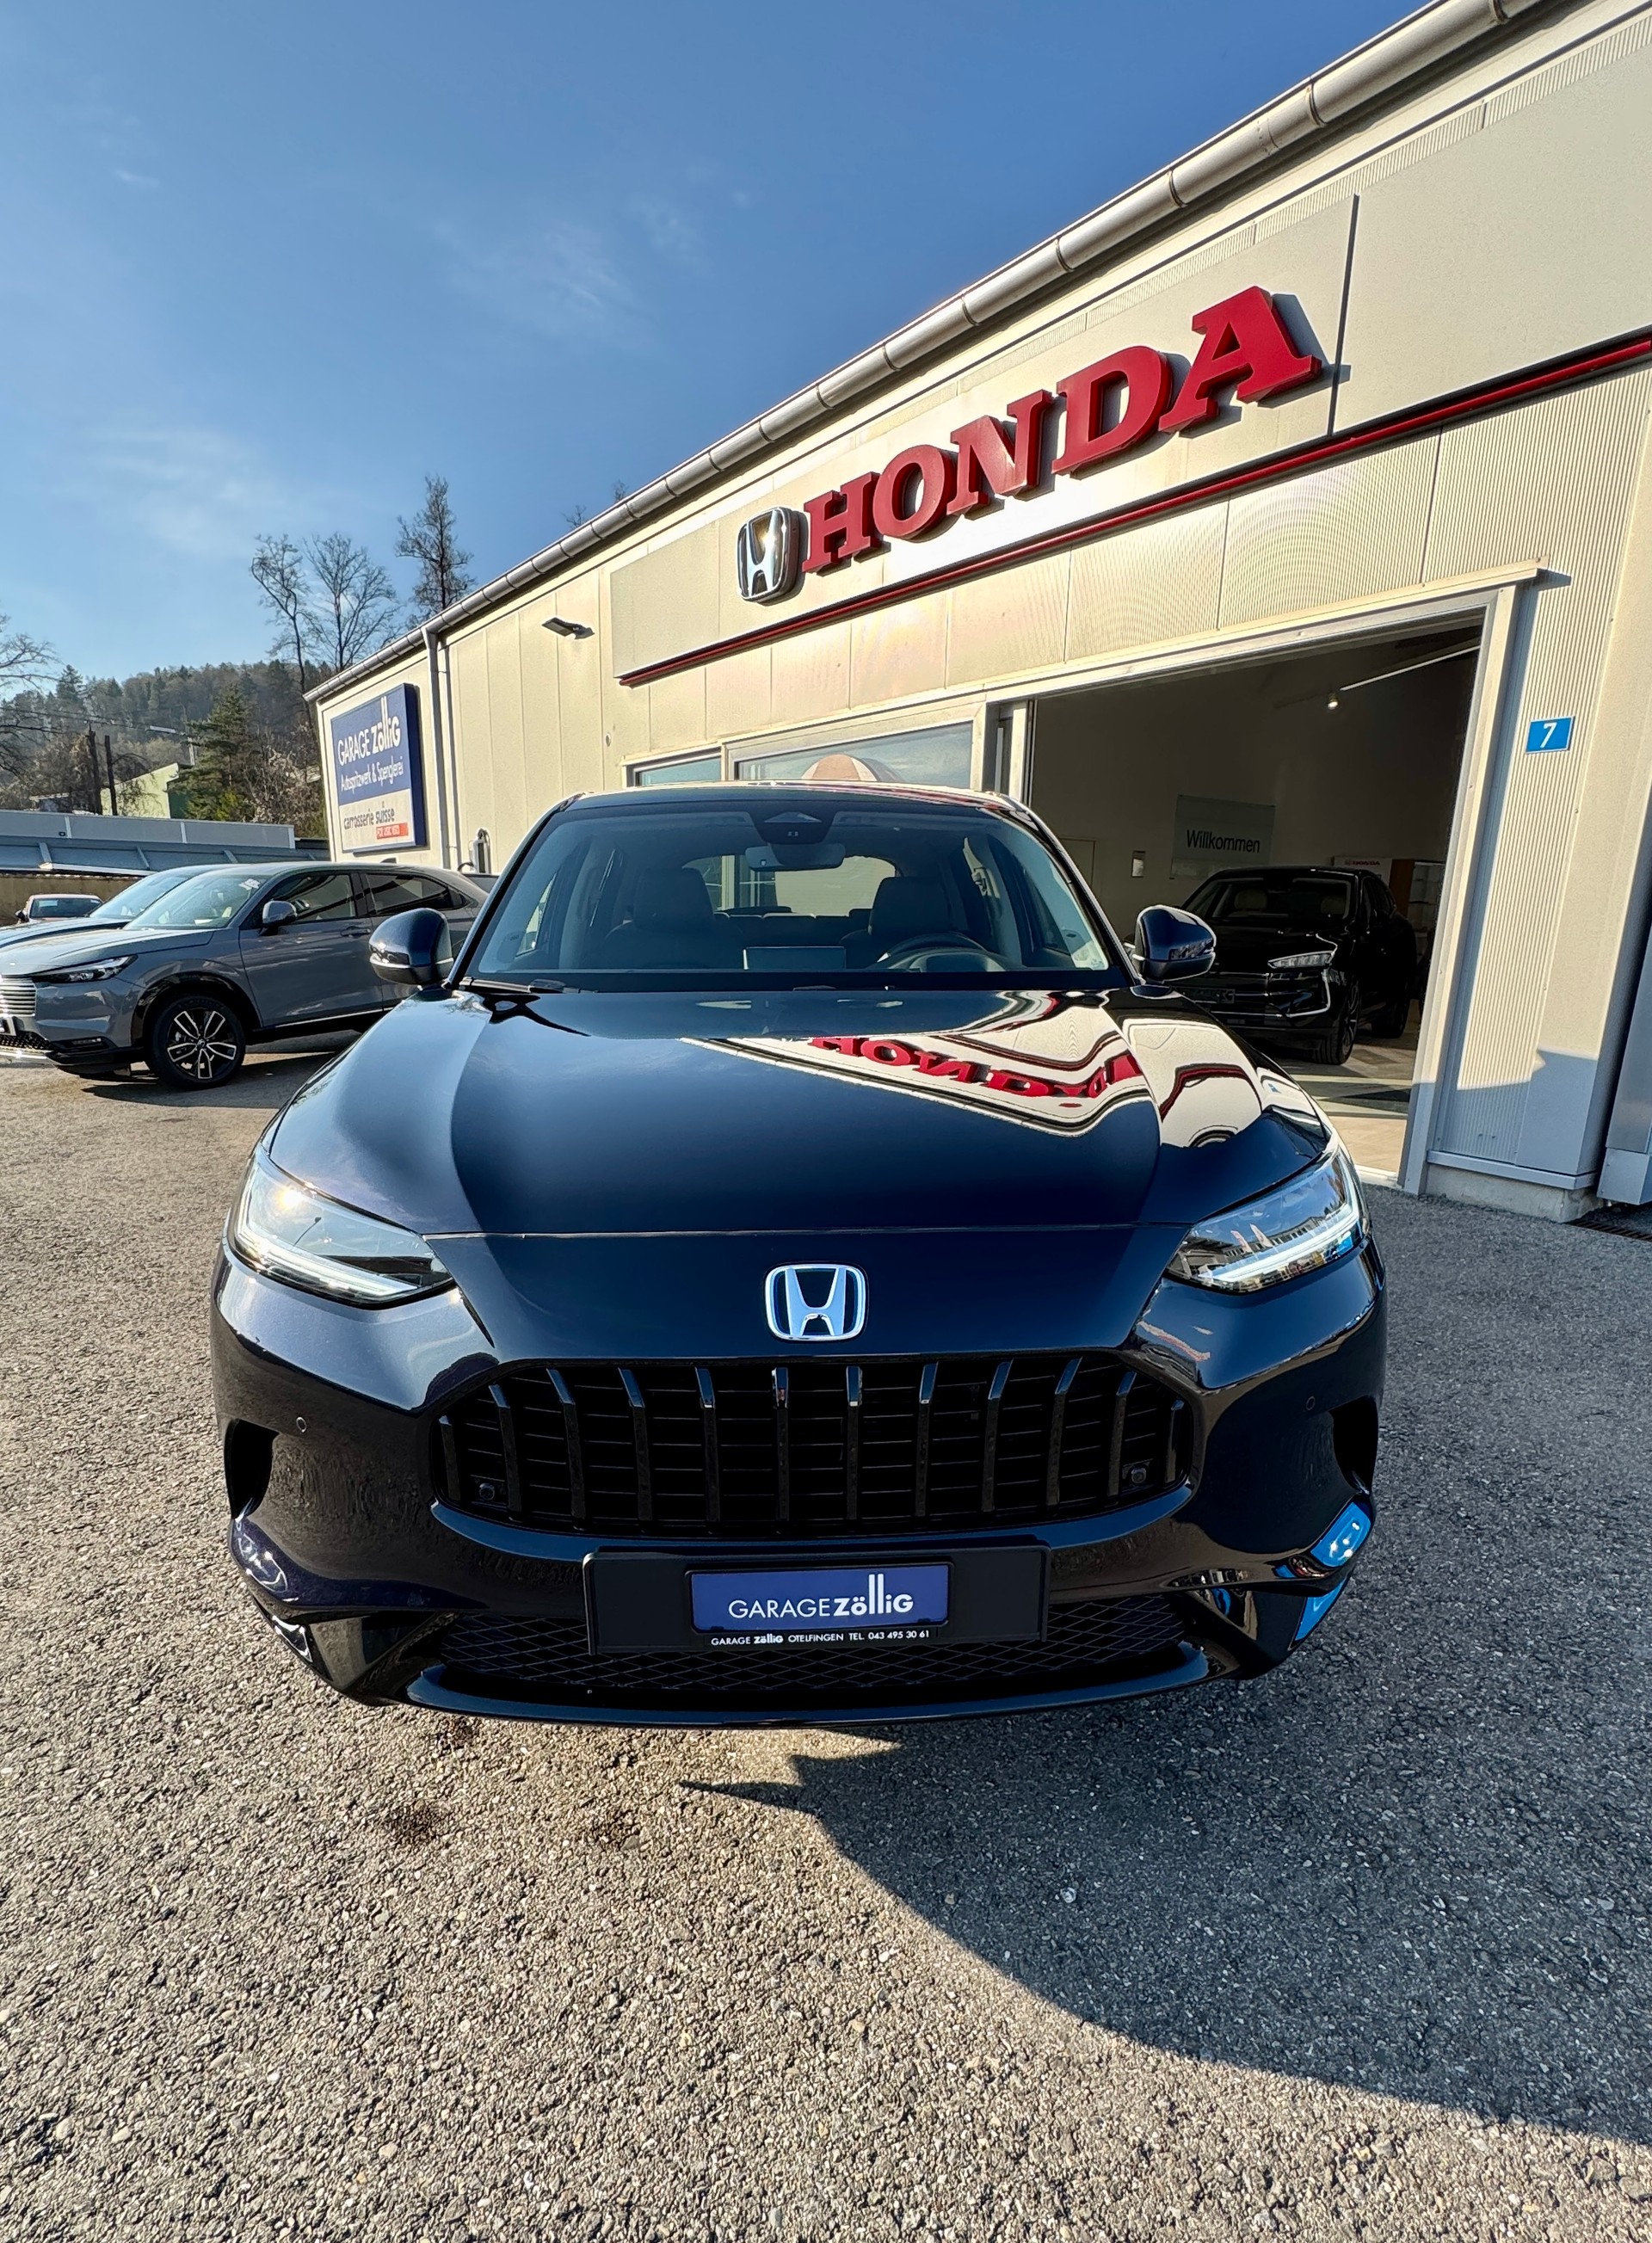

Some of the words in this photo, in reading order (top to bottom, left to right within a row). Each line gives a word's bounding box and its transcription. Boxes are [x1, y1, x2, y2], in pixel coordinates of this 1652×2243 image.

[802, 286, 1322, 574] HONDA
[337, 729, 371, 767] GARAGE
[1539, 722, 1557, 749] 7
[372, 763, 377, 783] &
[377, 755, 404, 787] Spenglerei
[344, 808, 374, 829] carrosserie
[1187, 829, 1261, 853] Willkommen
[728, 1598, 830, 1619] GARAGE
[711, 1636, 751, 1646] GARAGE
[788, 1633, 844, 1643] OTELFINGEN
[867, 1631, 885, 1640] 043
[887, 1631, 903, 1640] 495
